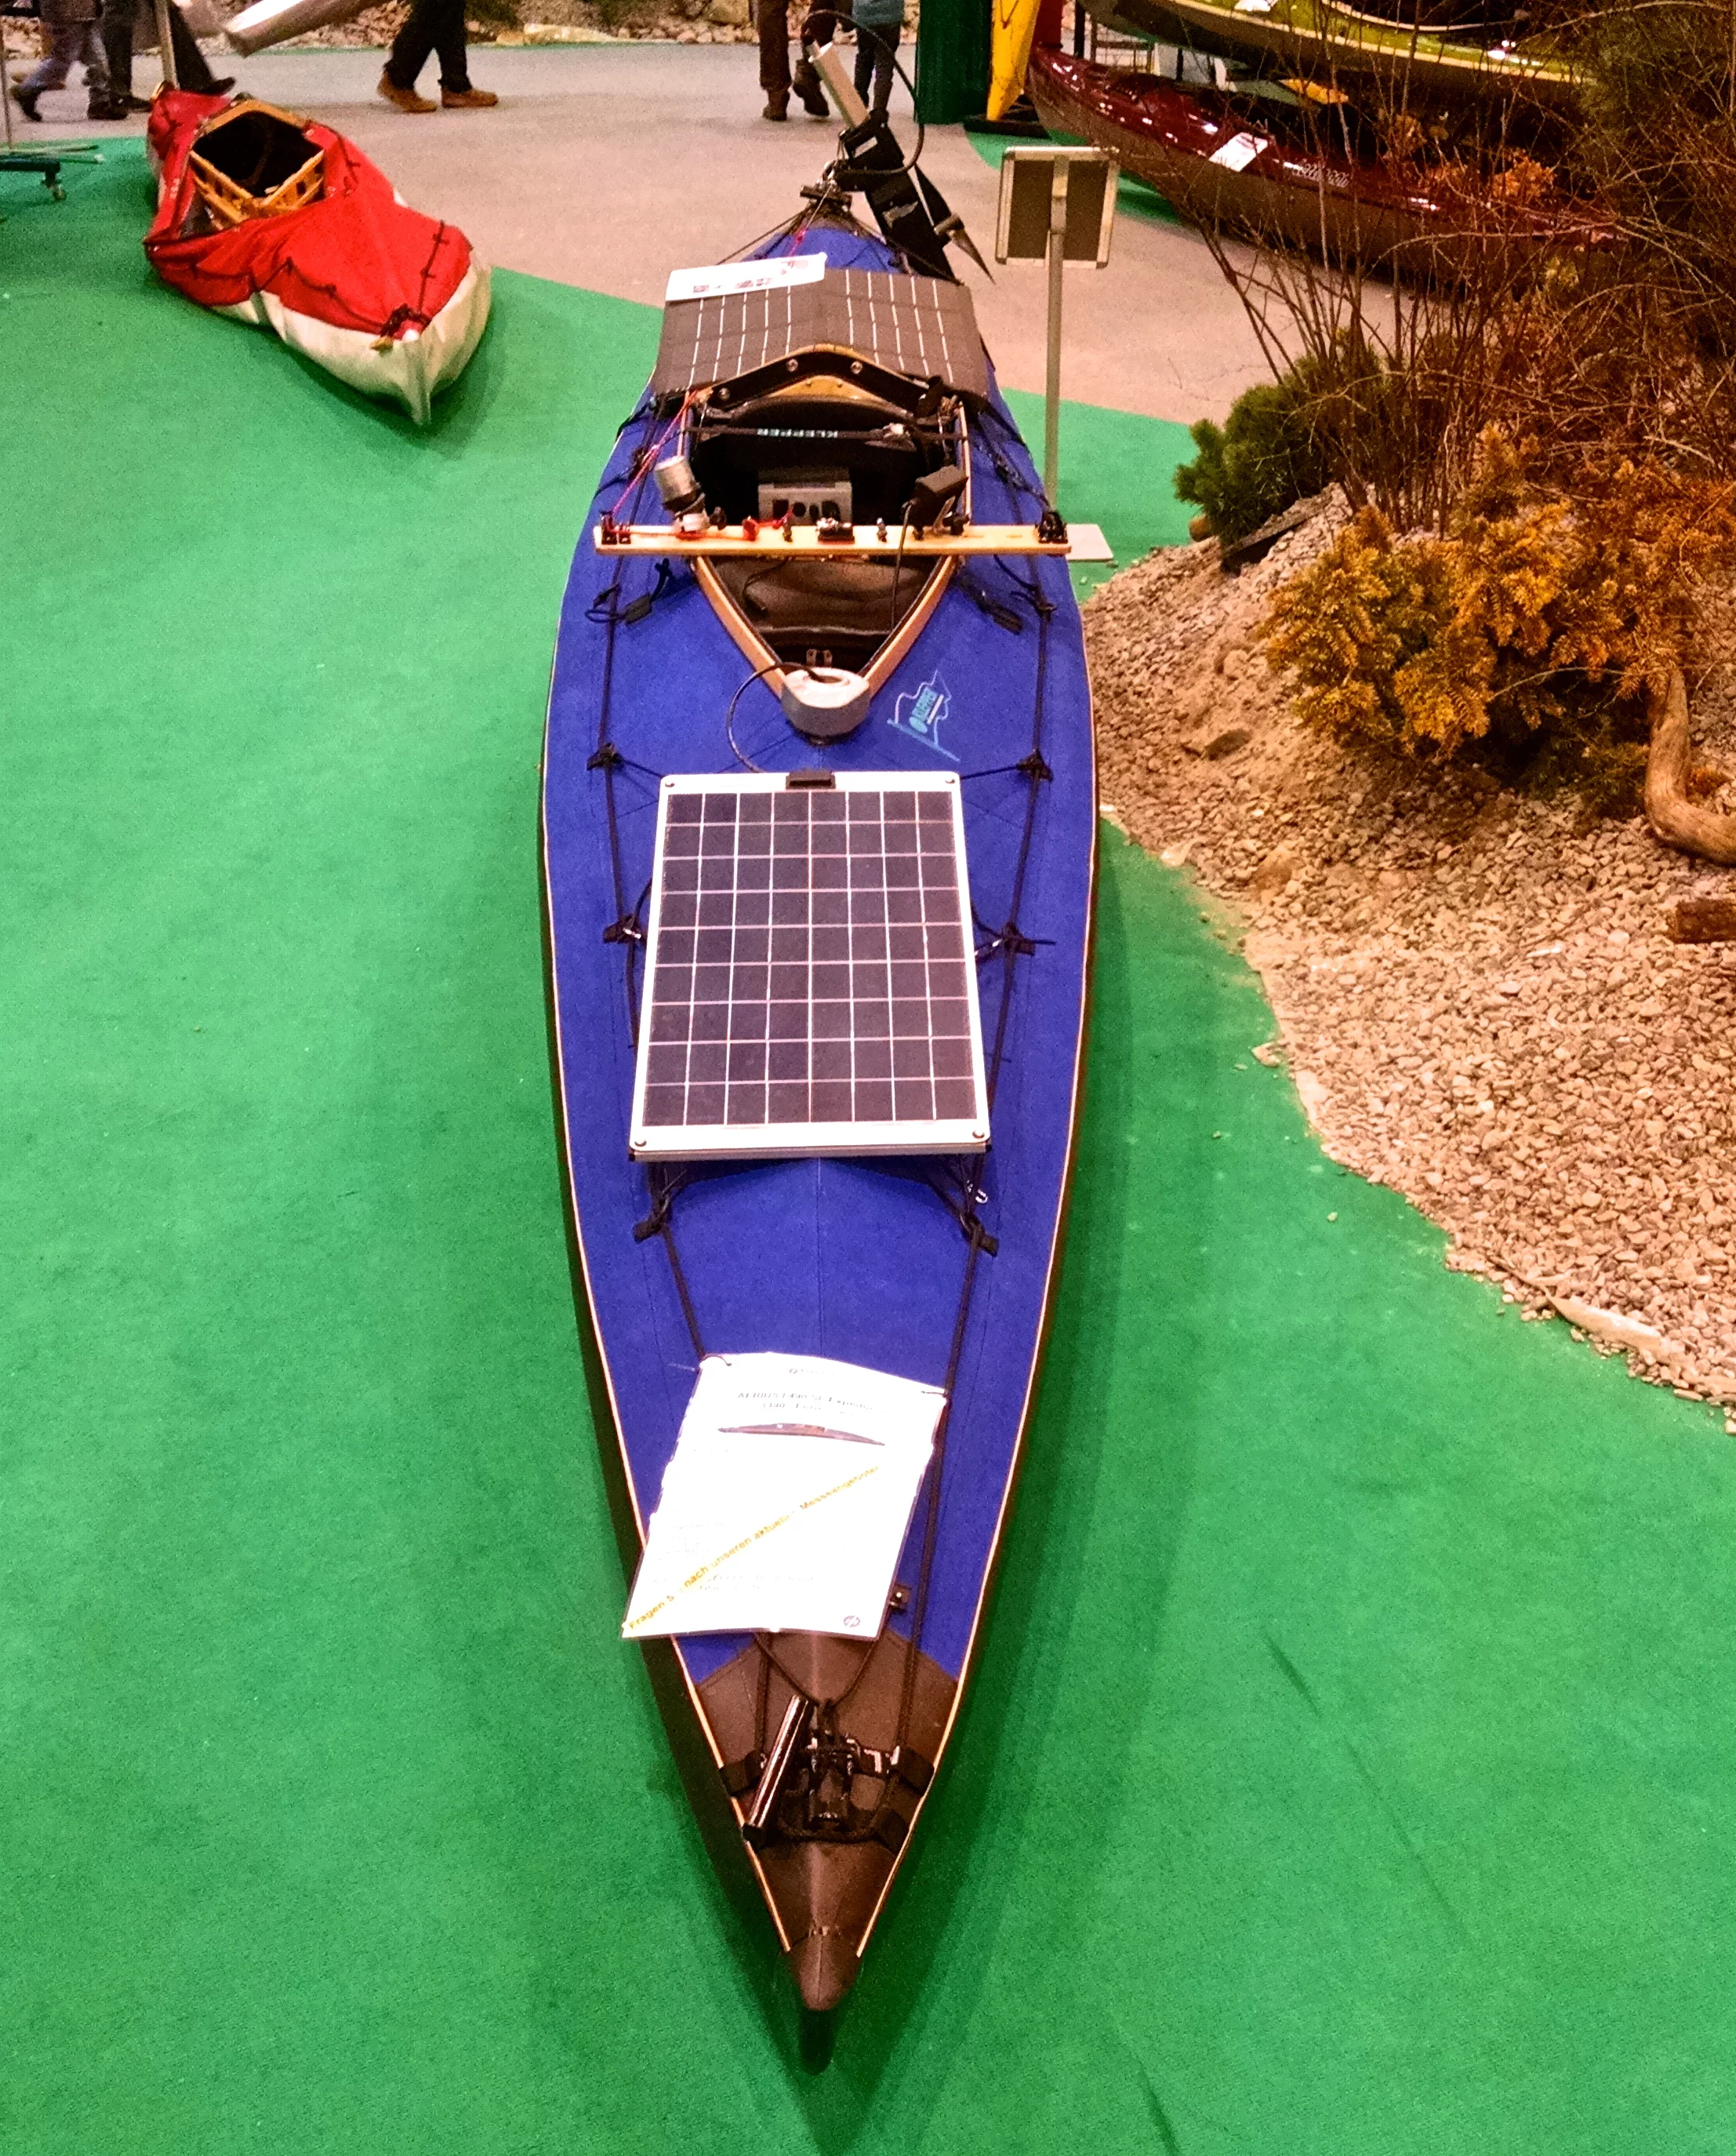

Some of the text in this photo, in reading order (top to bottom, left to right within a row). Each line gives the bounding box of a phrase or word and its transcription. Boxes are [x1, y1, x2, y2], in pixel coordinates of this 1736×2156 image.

[629, 1601, 666, 1630] Fragen
[684, 1565, 709, 1588] nach
[710, 1537, 752, 1568] unseren
